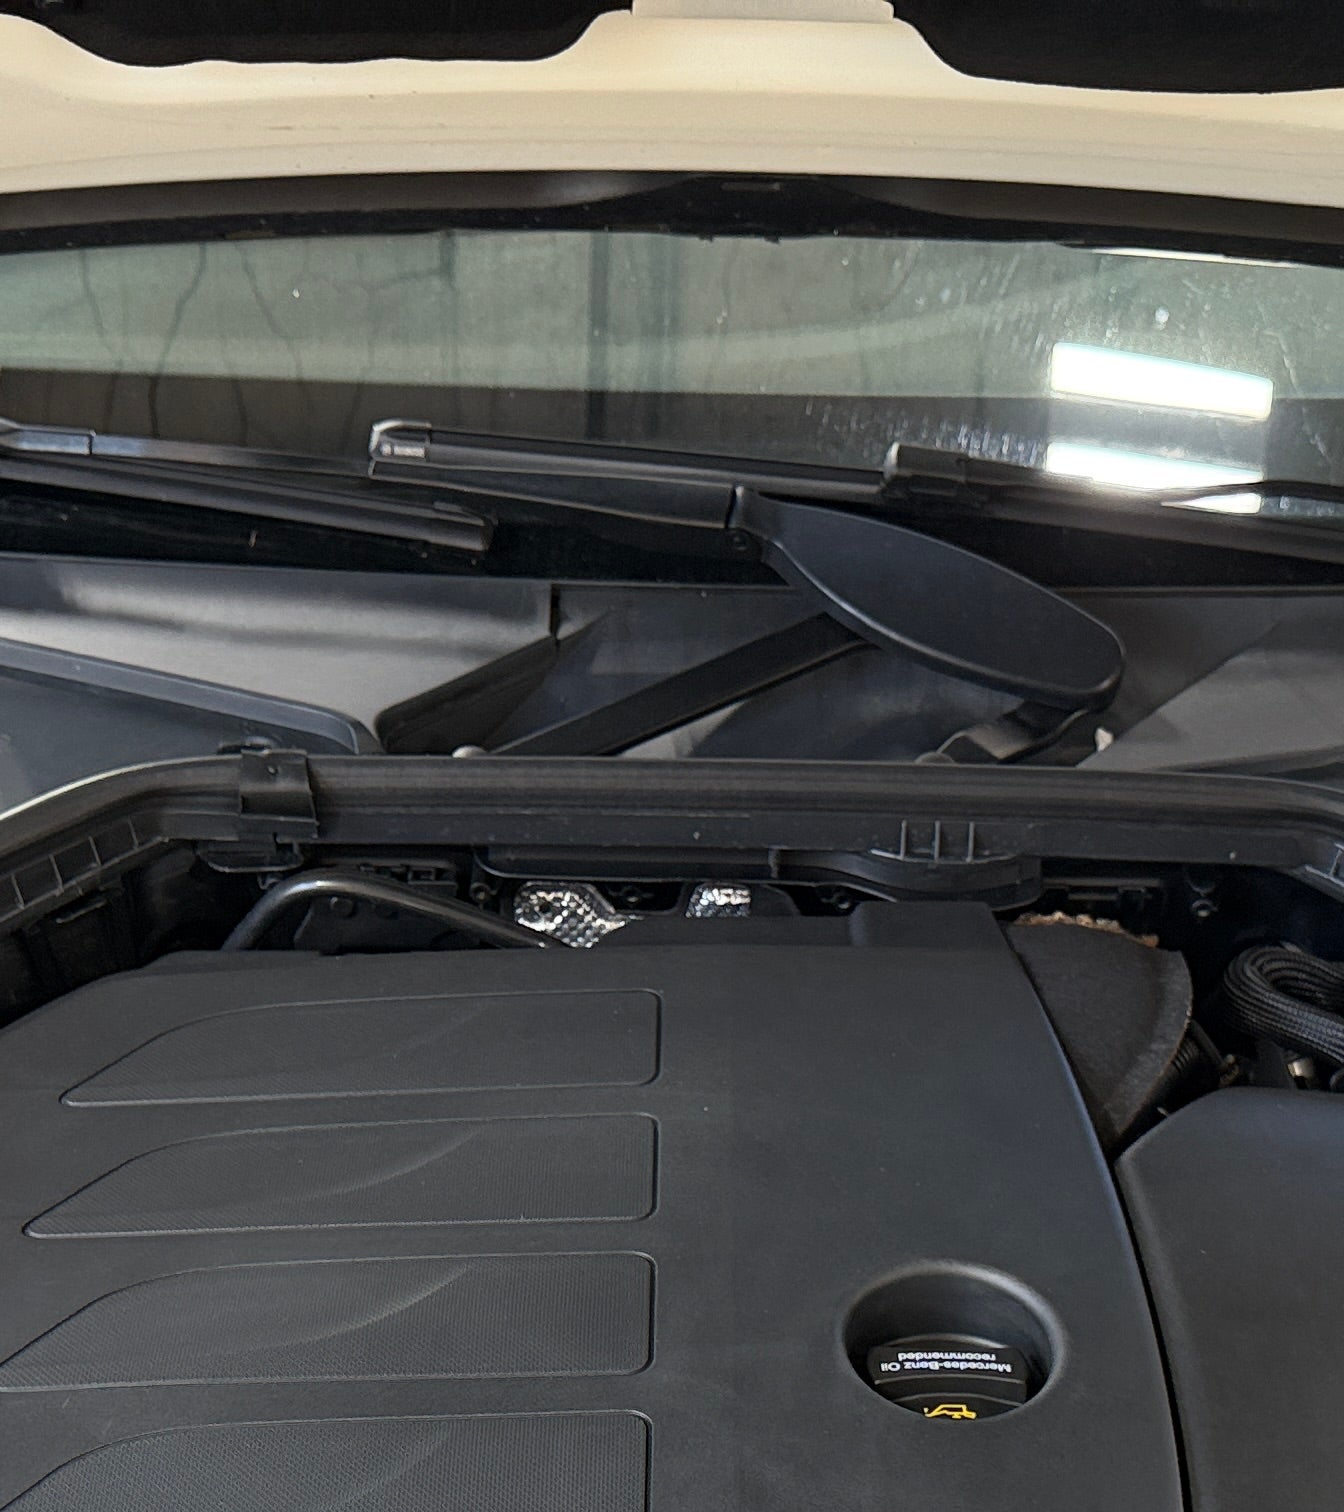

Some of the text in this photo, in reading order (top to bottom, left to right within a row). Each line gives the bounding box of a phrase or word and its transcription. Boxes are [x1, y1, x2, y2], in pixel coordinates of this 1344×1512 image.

[897, 1351, 996, 1361] recommended
[880, 1361, 1012, 1373] Mercedes-Benz Oil
